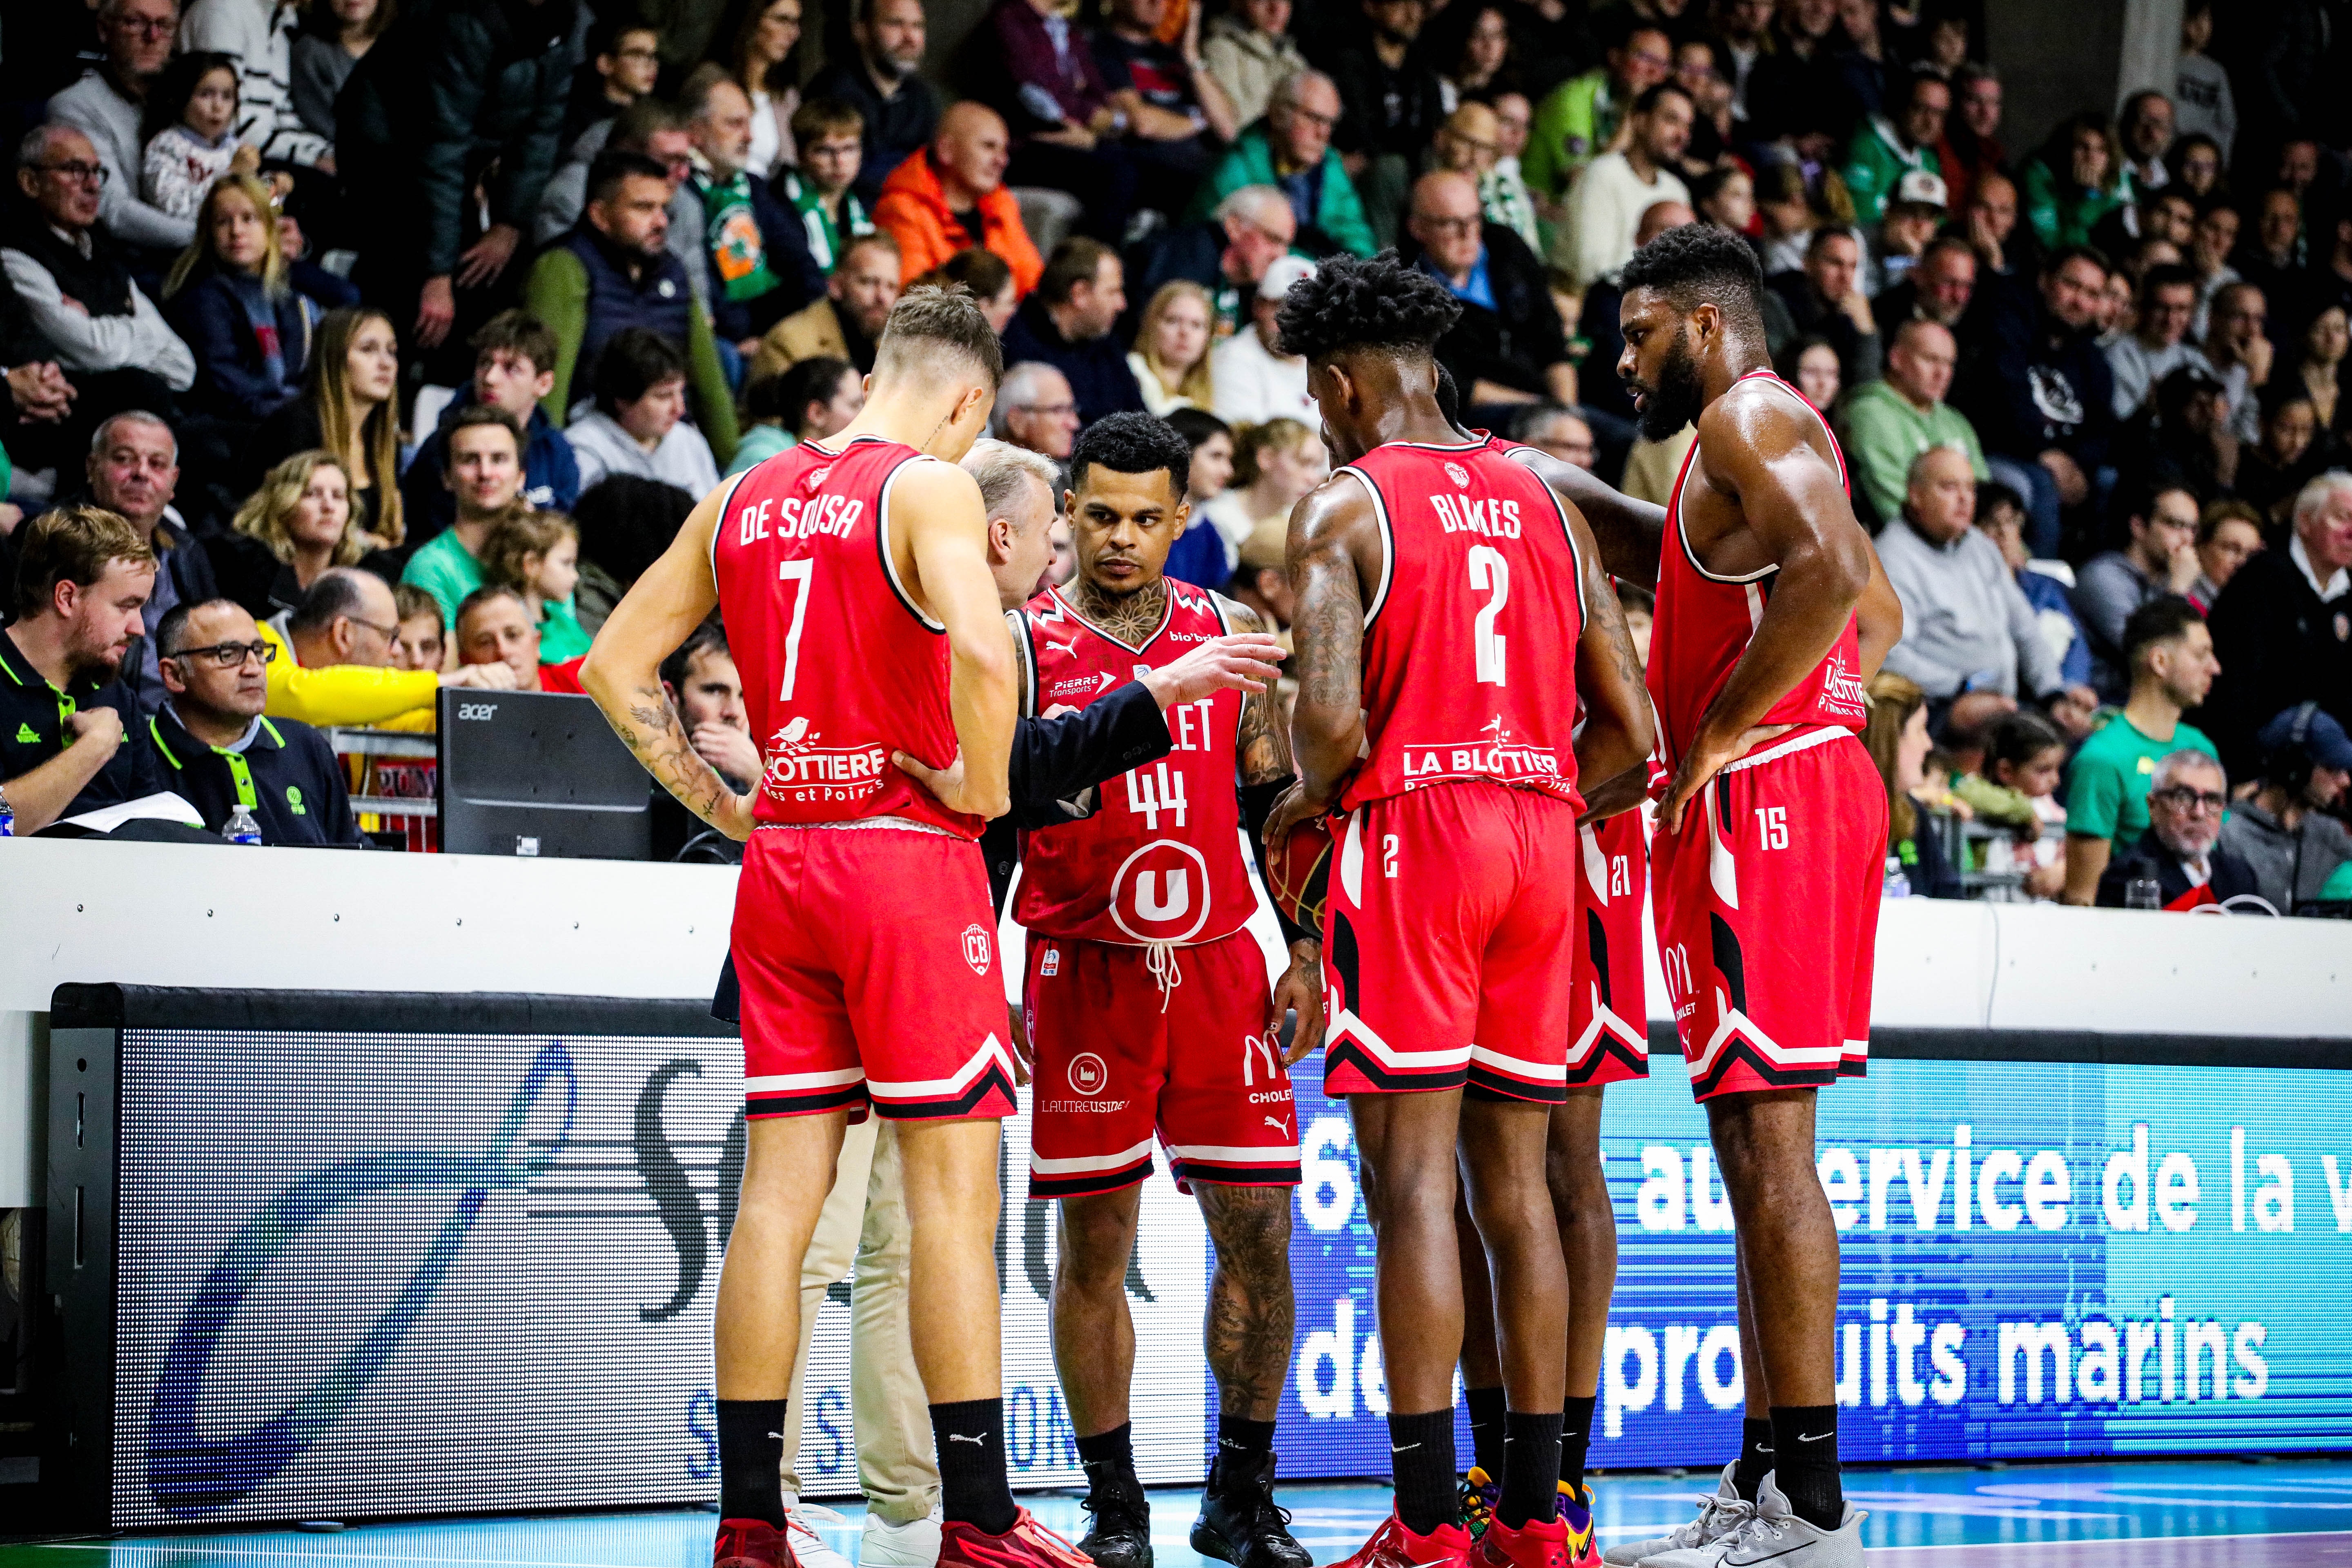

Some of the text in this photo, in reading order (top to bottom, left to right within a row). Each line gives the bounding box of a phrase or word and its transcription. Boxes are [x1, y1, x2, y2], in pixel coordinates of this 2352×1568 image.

[740, 494, 864, 546] DE SOUSA
[780, 557, 814, 702] 7
[1468, 544, 1509, 687] 2
[458, 703, 498, 721] acer
[1049, 685, 1091, 697] Transports
[1403, 752, 1443, 776] LA
[795, 788, 816, 802] et
[1125, 762, 1187, 830] 44
[1755, 806, 1789, 851] 15
[1383, 834, 1399, 878] 2
[1612, 855, 1631, 896] 21
[967, 935, 989, 964] CB
[1676, 1002, 1696, 1022] CHOLET
[1249, 1088, 1293, 1104] CHOLET
[1816, 1124, 2071, 1232] ervice
[2101, 1123, 2201, 1232] de
[2231, 1125, 2294, 1232] la
[1603, 1299, 1966, 1438] prouits
[1998, 1297, 2269, 1406] marins
